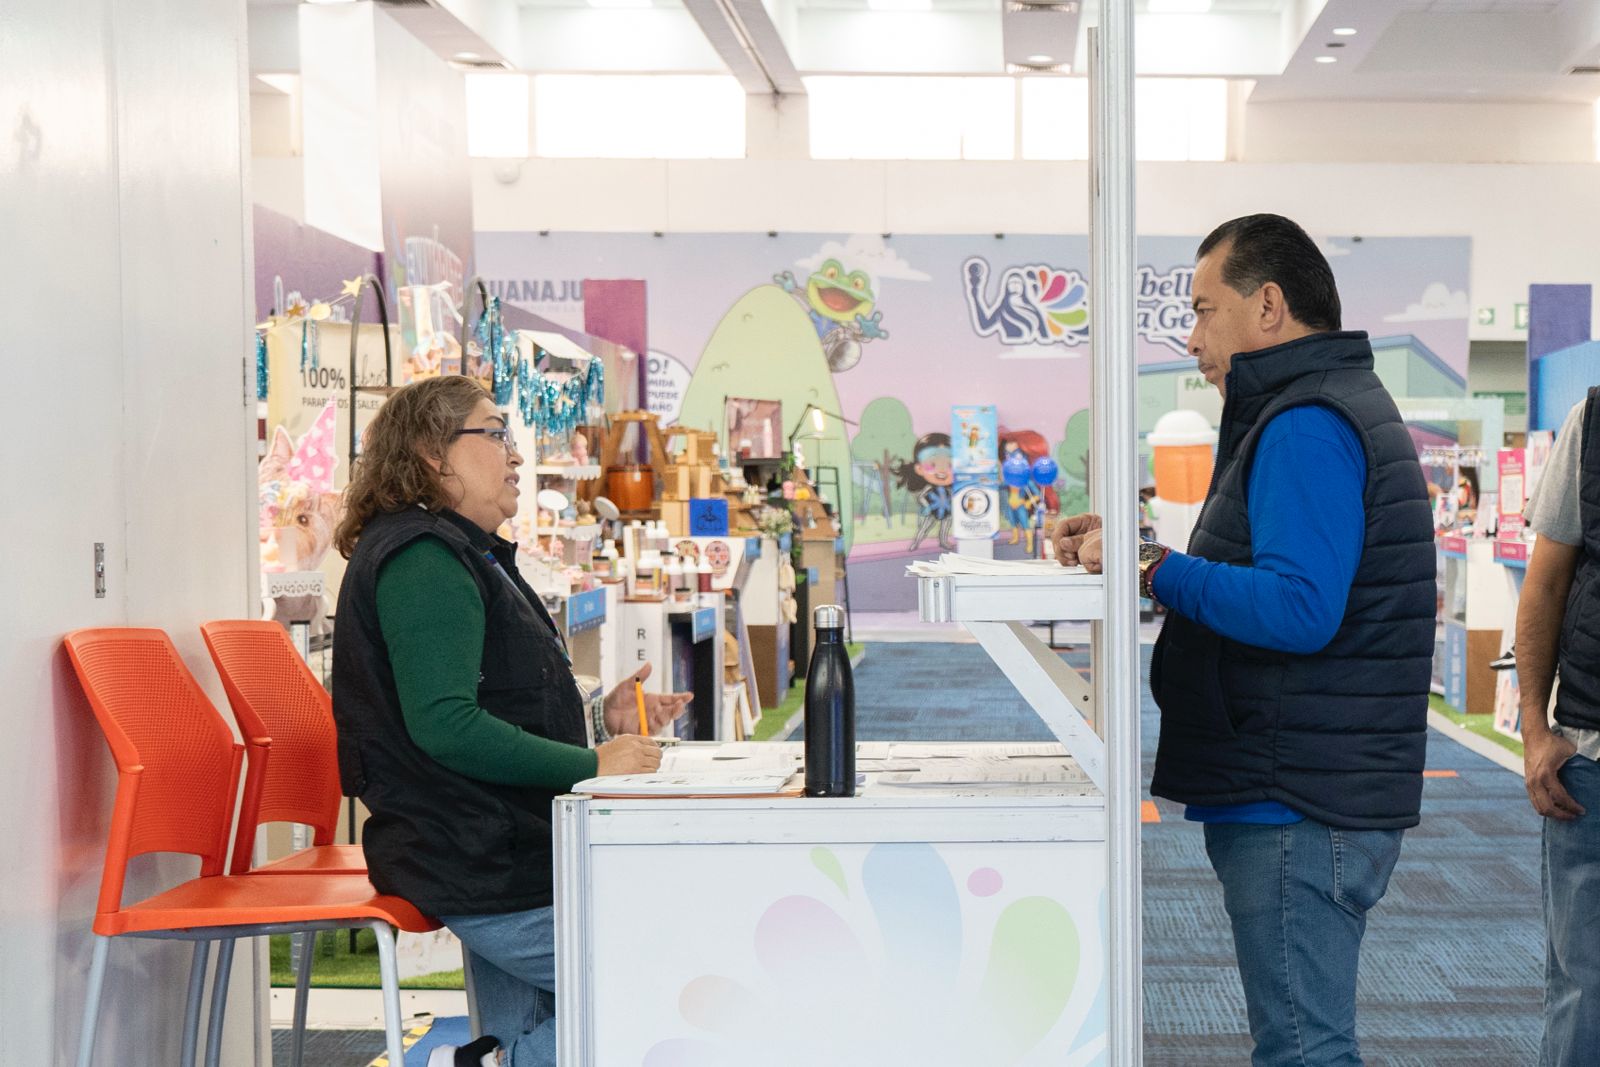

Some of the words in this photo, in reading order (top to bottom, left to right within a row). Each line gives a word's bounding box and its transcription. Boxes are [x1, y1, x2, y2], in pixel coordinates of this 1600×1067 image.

[488, 279, 585, 302] UANAJU
[1140, 271, 1192, 297] bell
[300, 367, 346, 389] 100%
[302, 397, 349, 409] PARABOS
